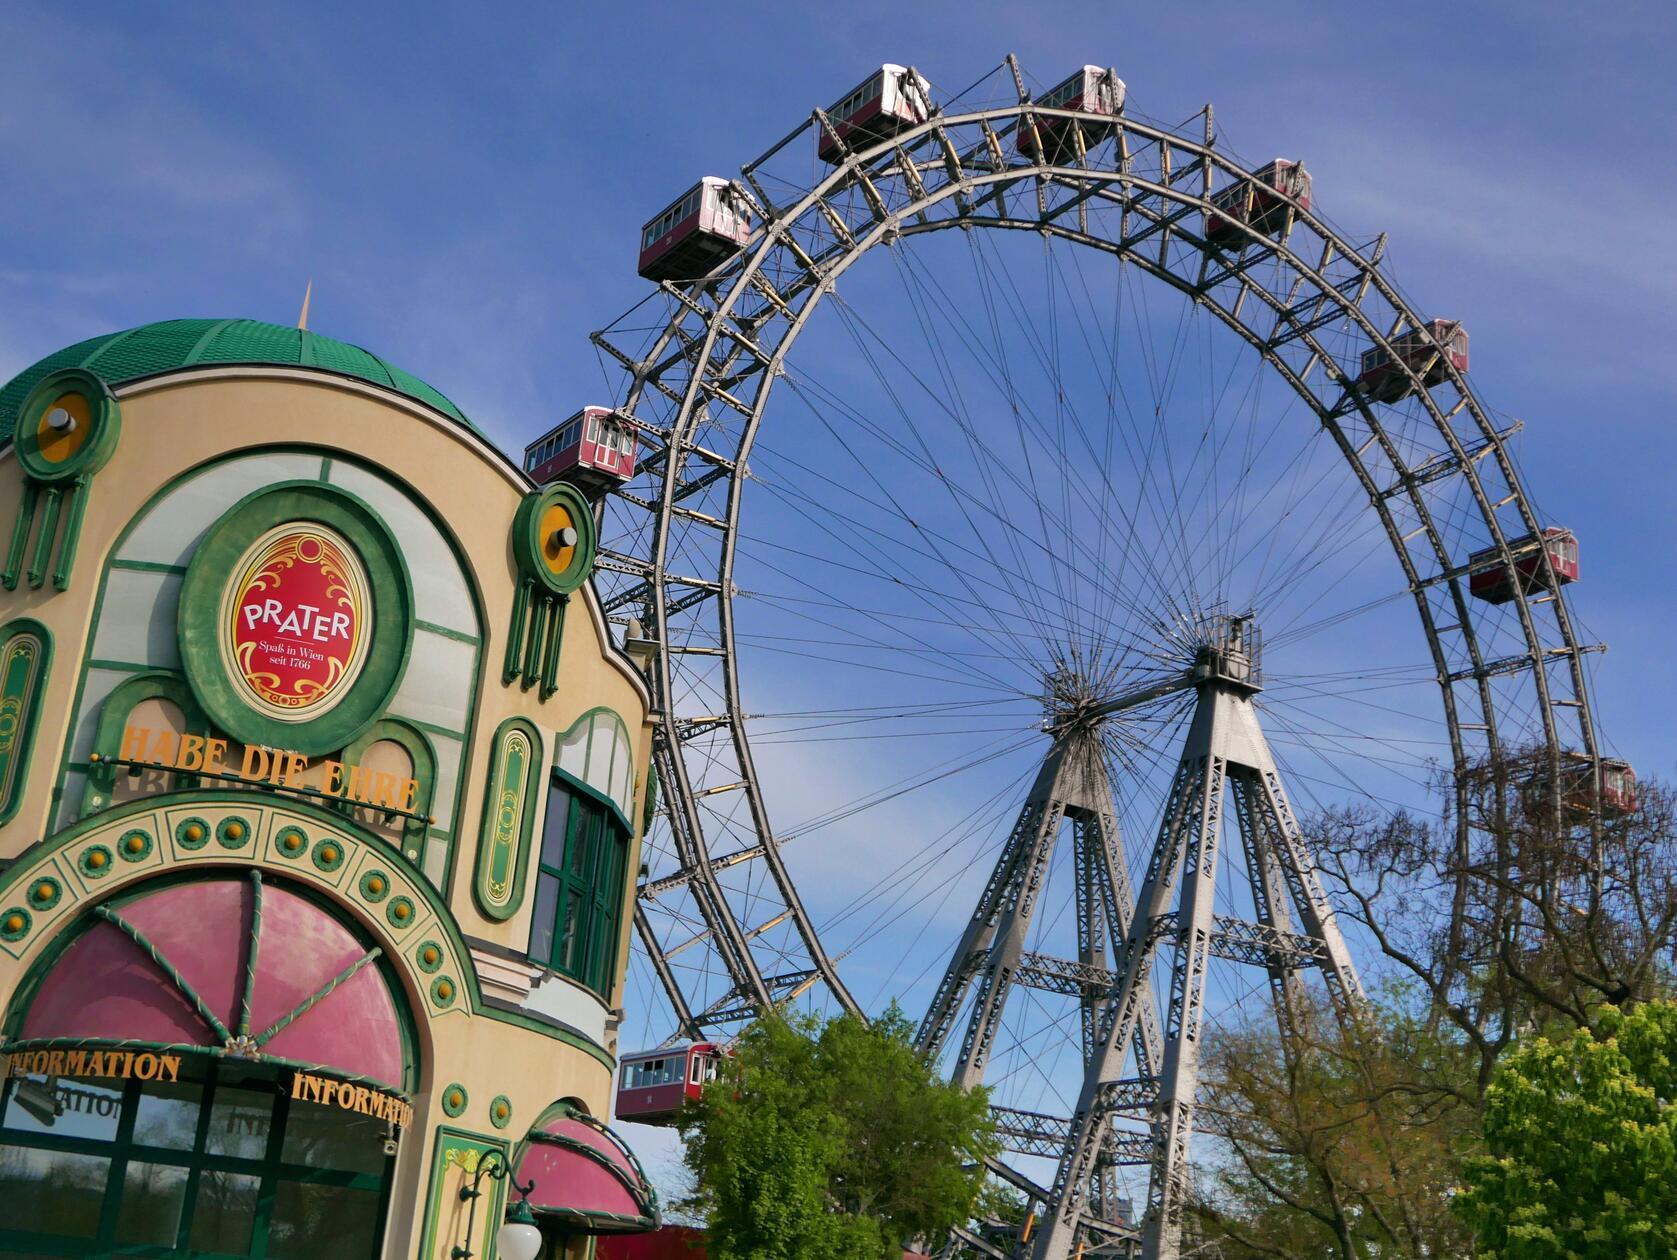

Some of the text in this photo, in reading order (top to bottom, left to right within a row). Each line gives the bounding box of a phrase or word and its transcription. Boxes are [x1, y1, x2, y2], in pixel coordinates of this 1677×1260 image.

[243, 598, 350, 642] PRATER
[259, 640, 324, 661] Spaß in Wien
[269, 655, 311, 670] seit 1766
[119, 726, 420, 815] HABE DIE EHRE
[7, 1050, 182, 1082] INFORMATION
